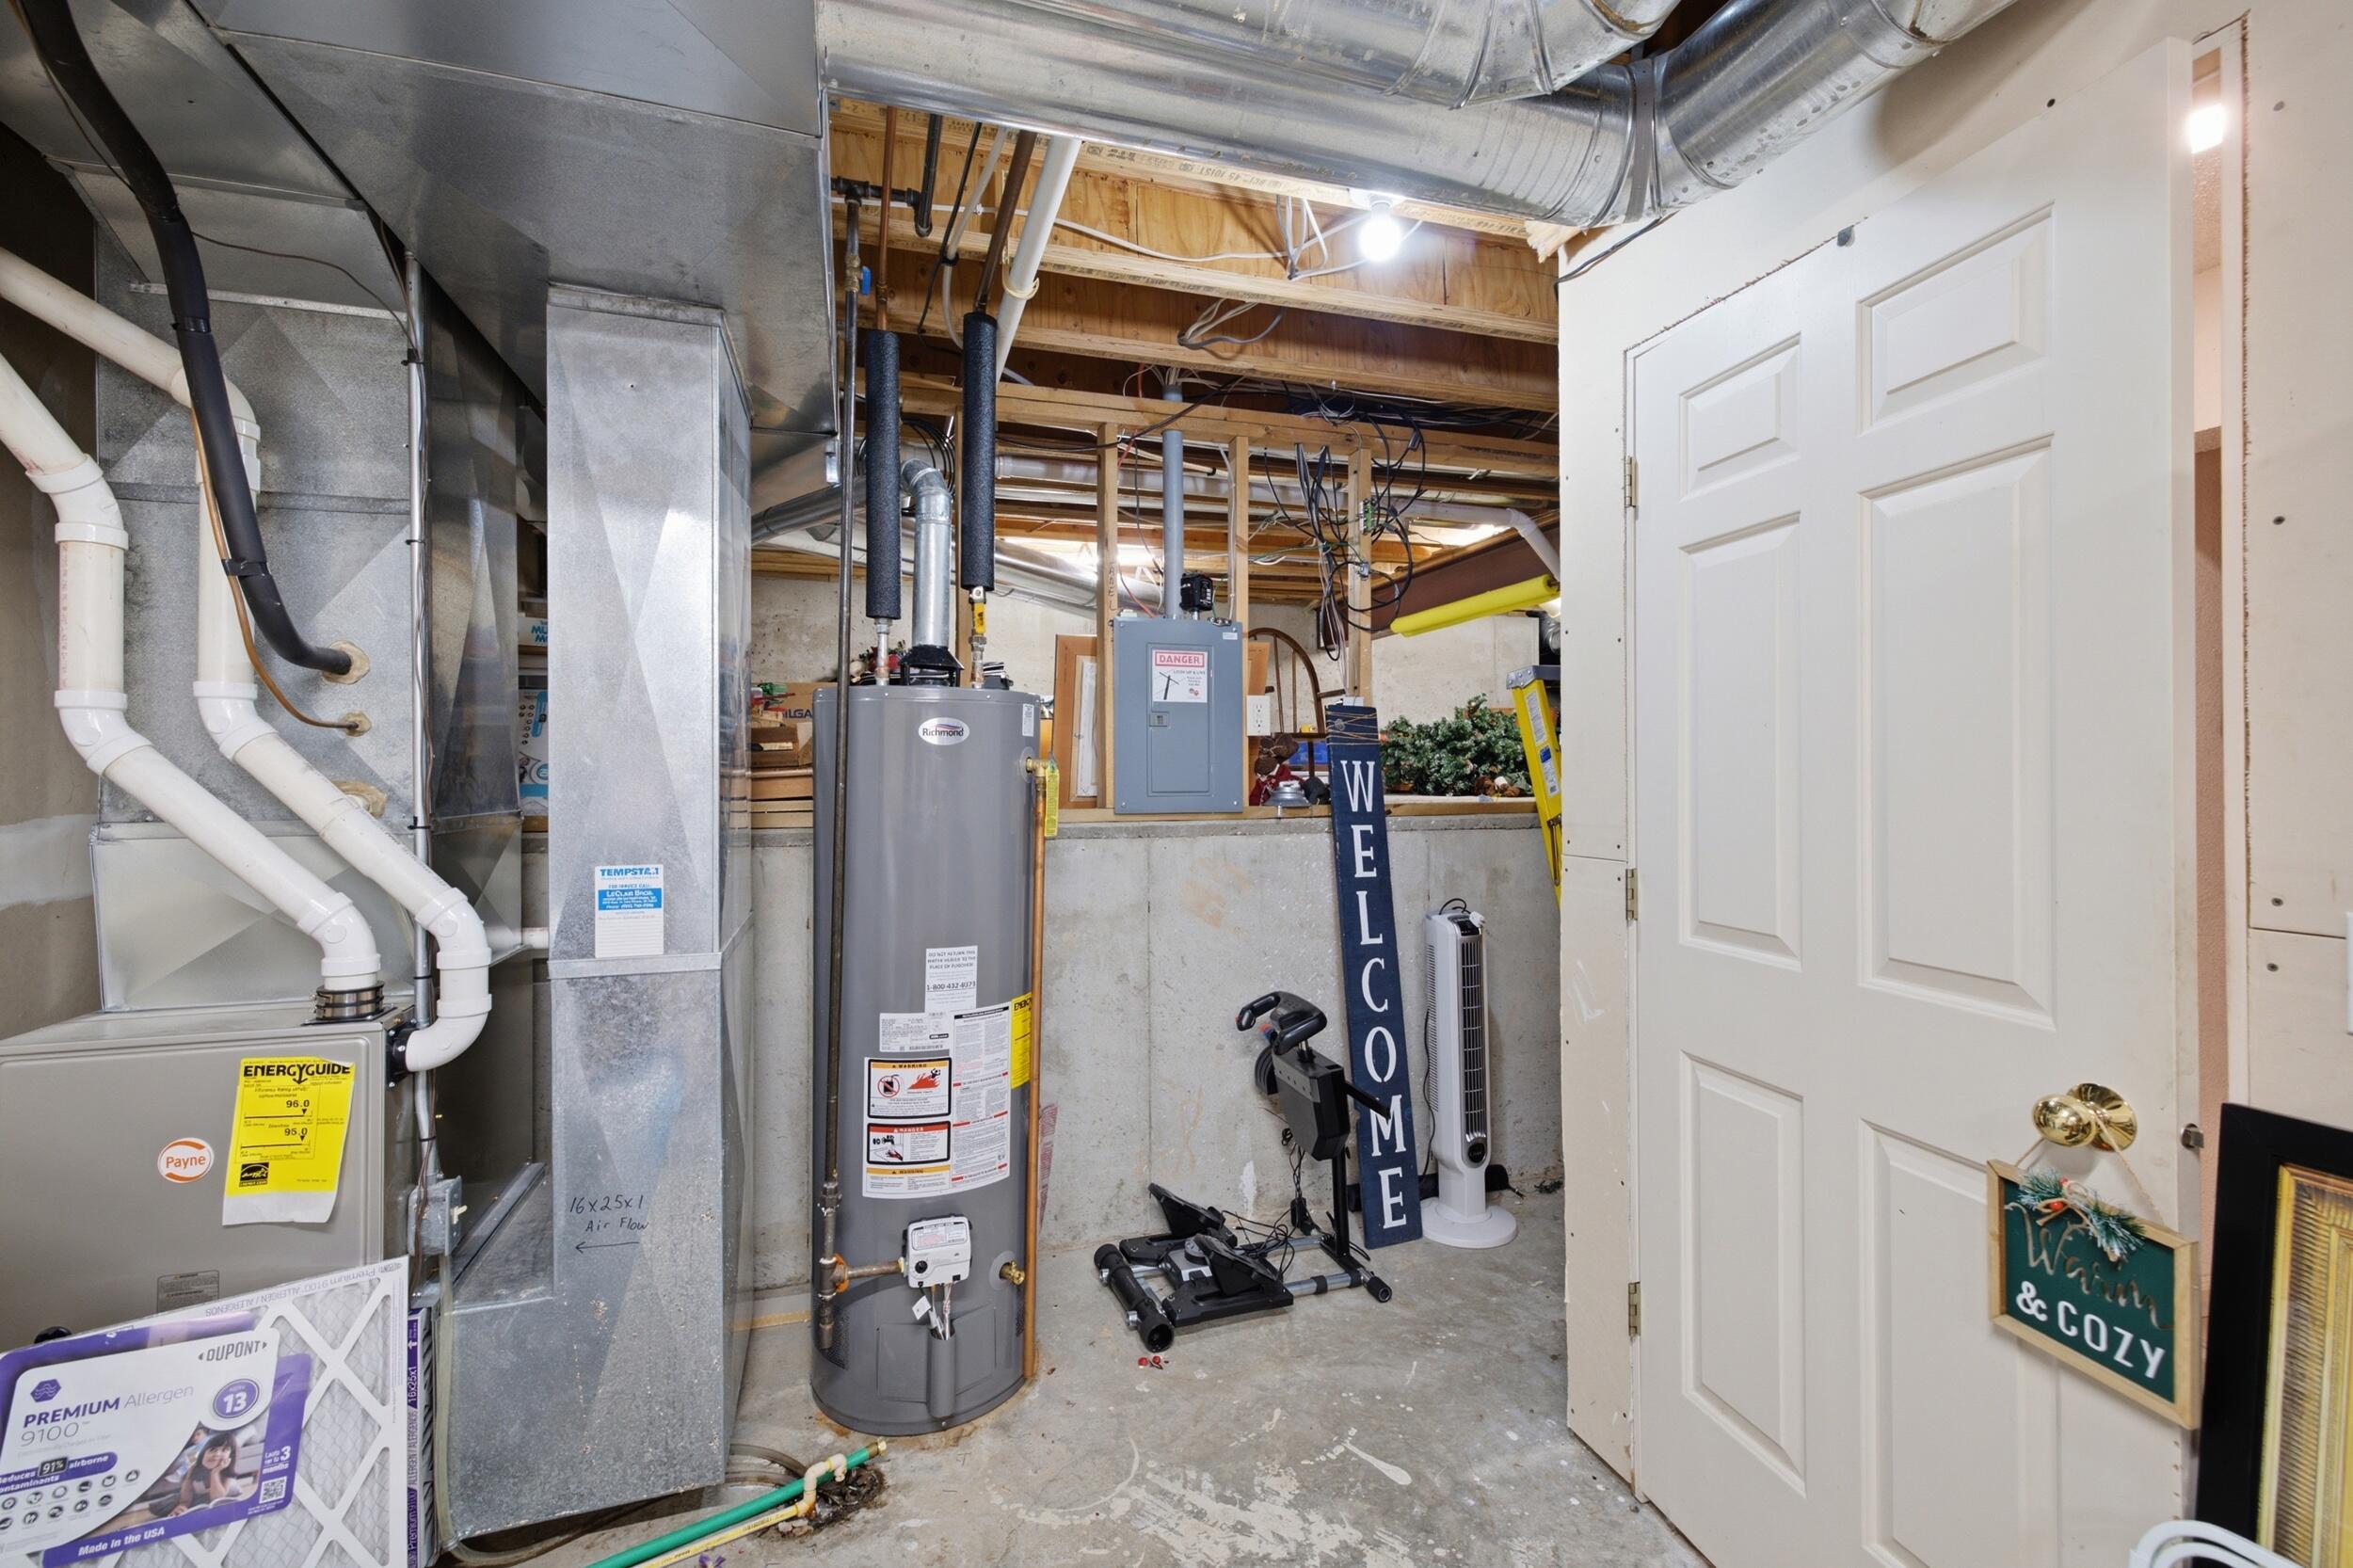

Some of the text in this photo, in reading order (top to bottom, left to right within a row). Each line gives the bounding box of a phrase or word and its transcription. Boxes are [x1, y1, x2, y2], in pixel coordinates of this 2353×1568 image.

[1159, 655, 1200, 664] DANGER
[922, 728, 965, 737] Richmond
[1340, 760, 1406, 1229] WELCOME
[244, 1064, 350, 1080] ENERGYGUIDE
[286, 1099, 310, 1108] 96.0
[284, 1128, 308, 1136] 95.0
[166, 1156, 206, 1170] Payne
[585, 1217, 649, 1232] Air Flow
[2004, 1202, 2175, 1330] Warm
[2016, 1281, 2165, 1379] & COZY
[206, 1340, 262, 1361] DUPONT
[408, 1366, 417, 1402] 16x25x1
[23, 1385, 194, 1428] PREMIUM Allergen
[223, 1391, 247, 1413] 13
[280, 1446, 291, 1461] 3
[42, 1461, 64, 1474] 91%
[69, 1455, 109, 1469] airborne
[0, 1475, 60, 1494] ontaminants
[78, 1527, 165, 1557] Made in the USA
